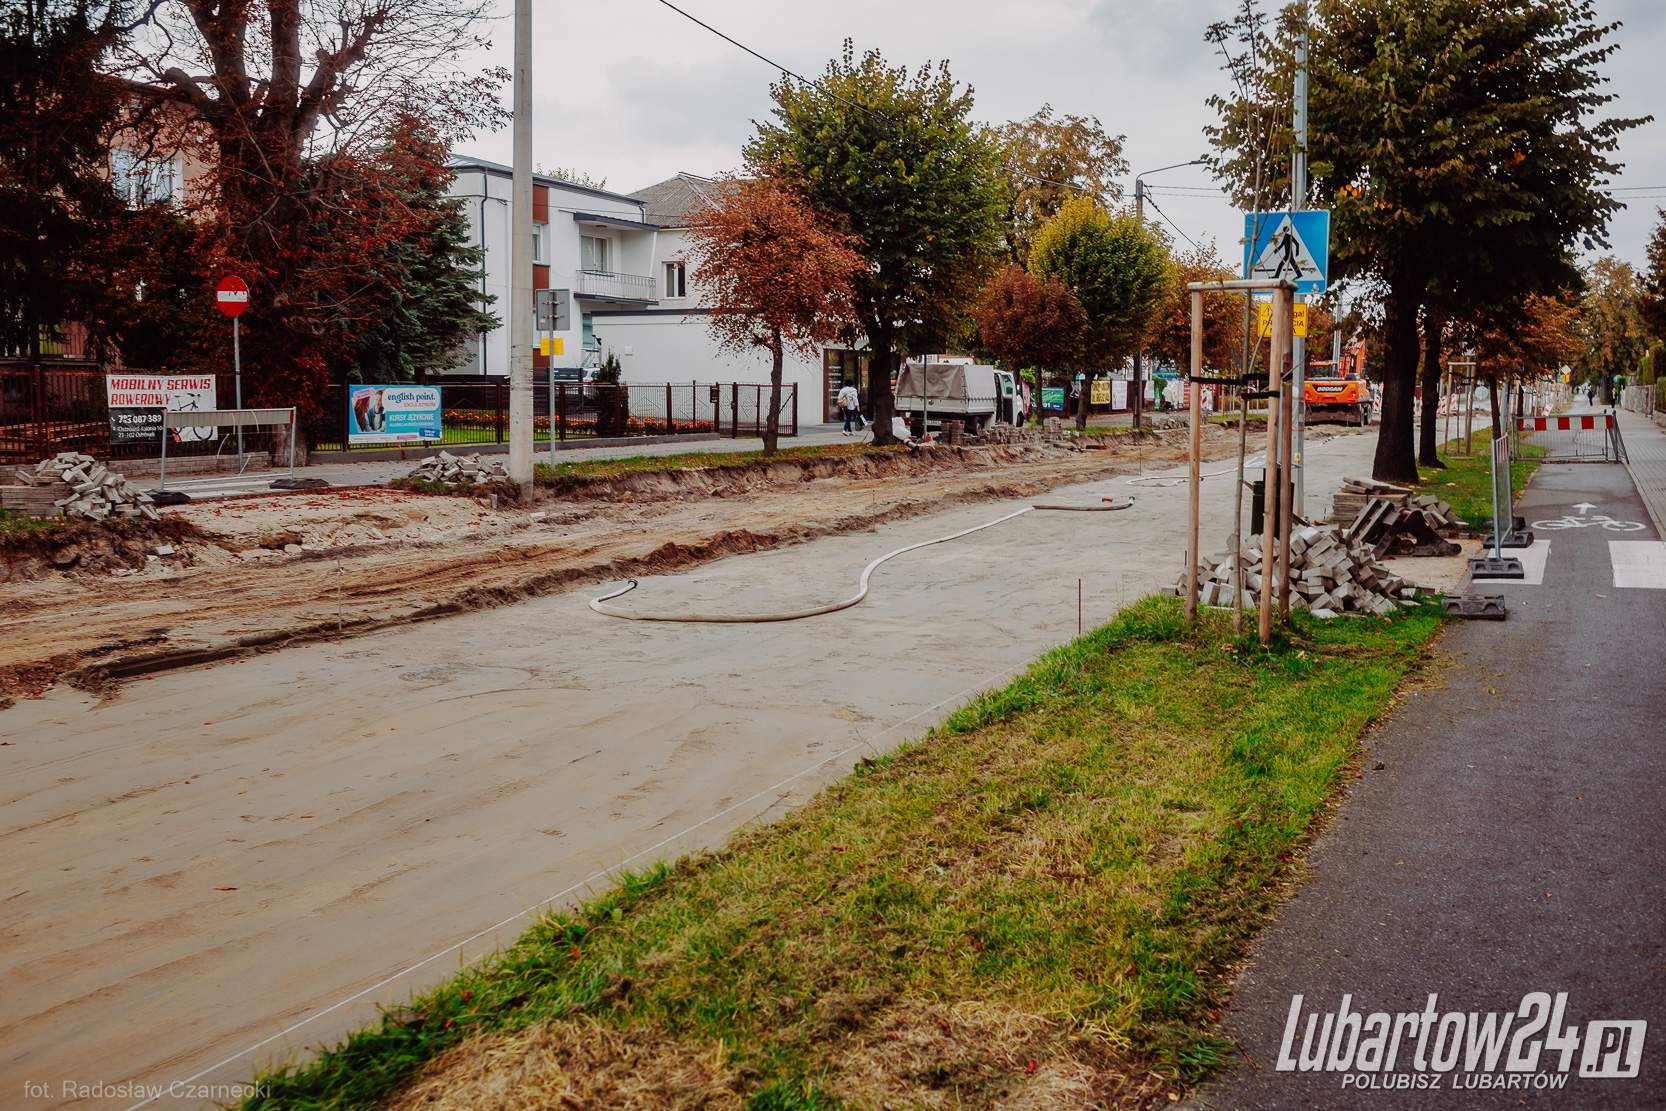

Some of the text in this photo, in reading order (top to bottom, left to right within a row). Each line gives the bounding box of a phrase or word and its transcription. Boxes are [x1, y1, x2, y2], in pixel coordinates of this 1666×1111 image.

[111, 378, 211, 390] MOBILNY SERWIS
[111, 393, 170, 405] ROWEROWY
[388, 392, 415, 404] english
[133, 415, 147, 424] 087
[147, 414, 162, 423] 389
